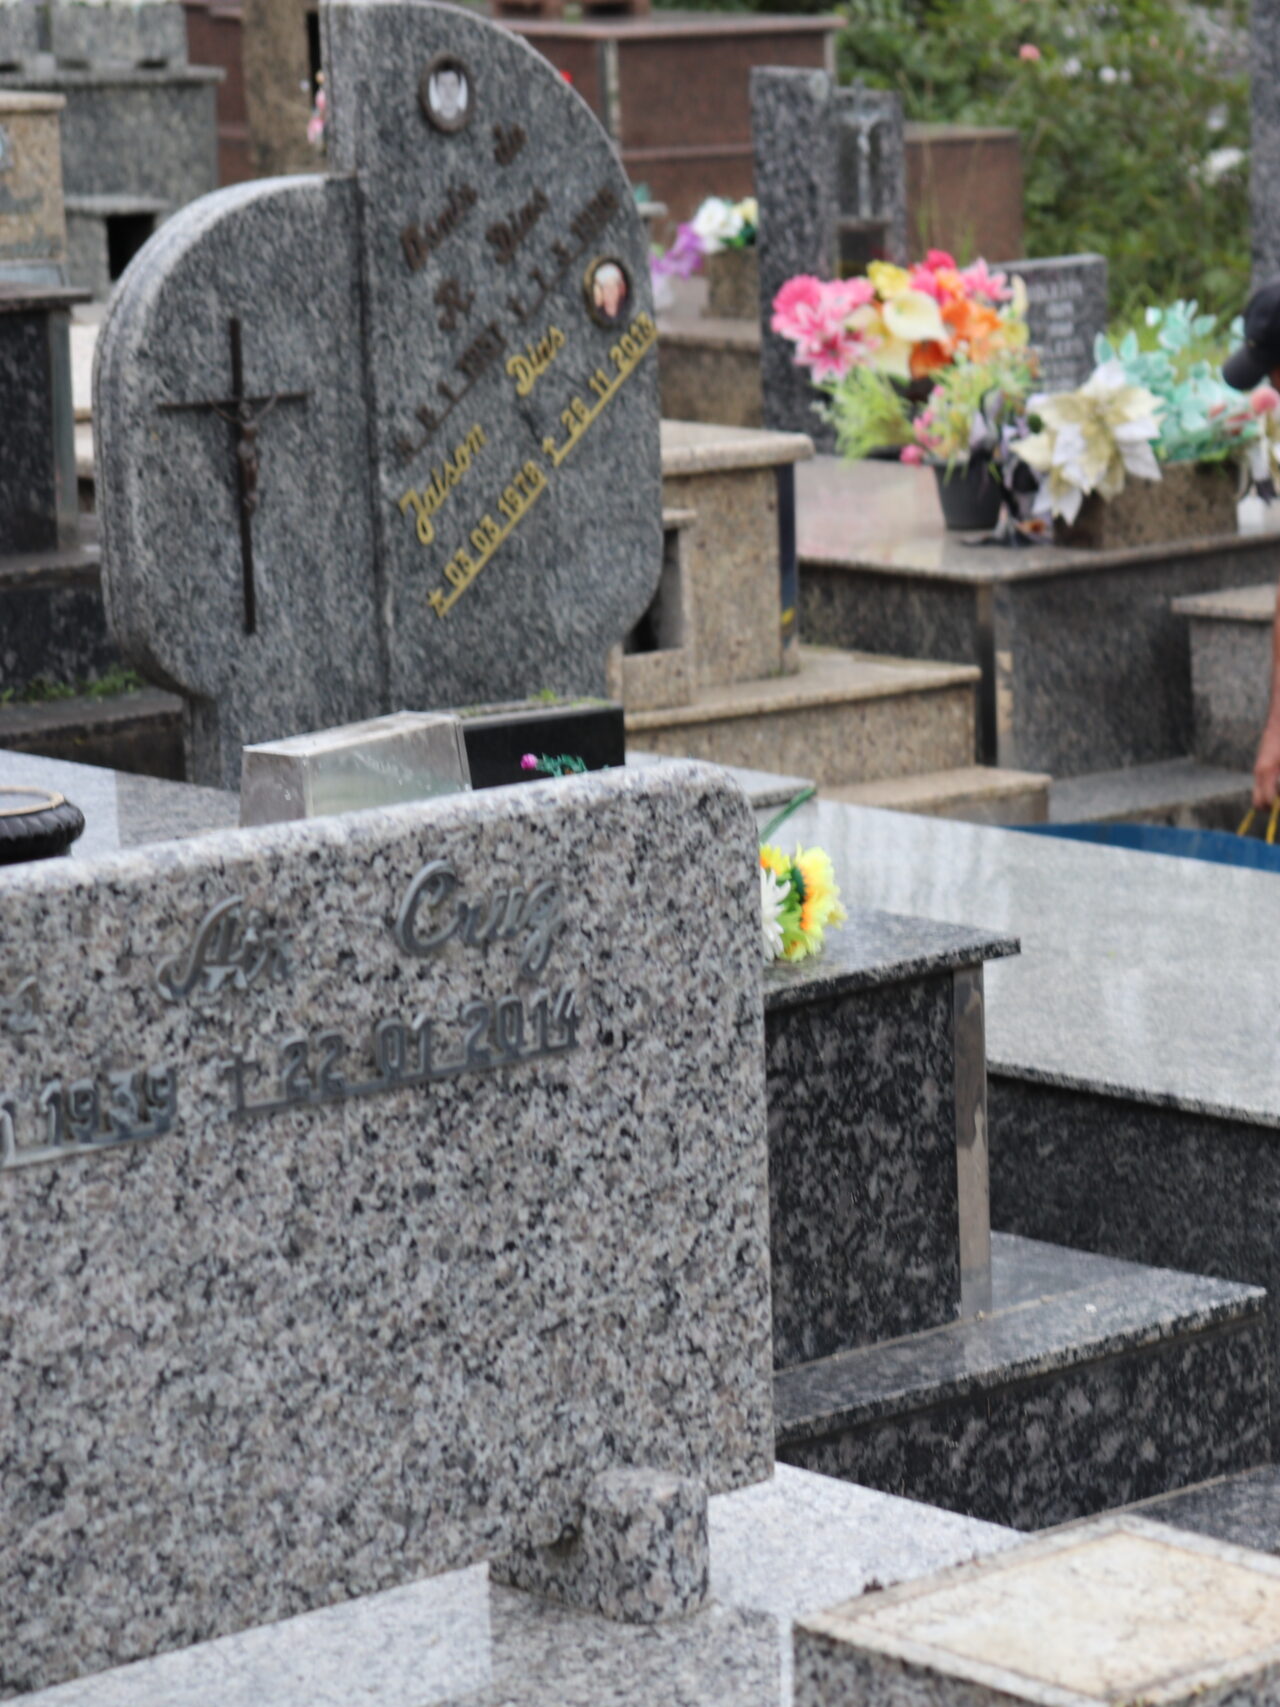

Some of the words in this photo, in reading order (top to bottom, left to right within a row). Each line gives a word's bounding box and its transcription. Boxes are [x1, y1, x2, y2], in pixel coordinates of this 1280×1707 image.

[400, 423, 490, 545] Jaison
[506, 325, 566, 397] Dias
[588, 367, 615, 402] 11
[280, 1030, 347, 1100] 22
[375, 1012, 434, 1084] 01
[460, 983, 582, 1066] 2014
